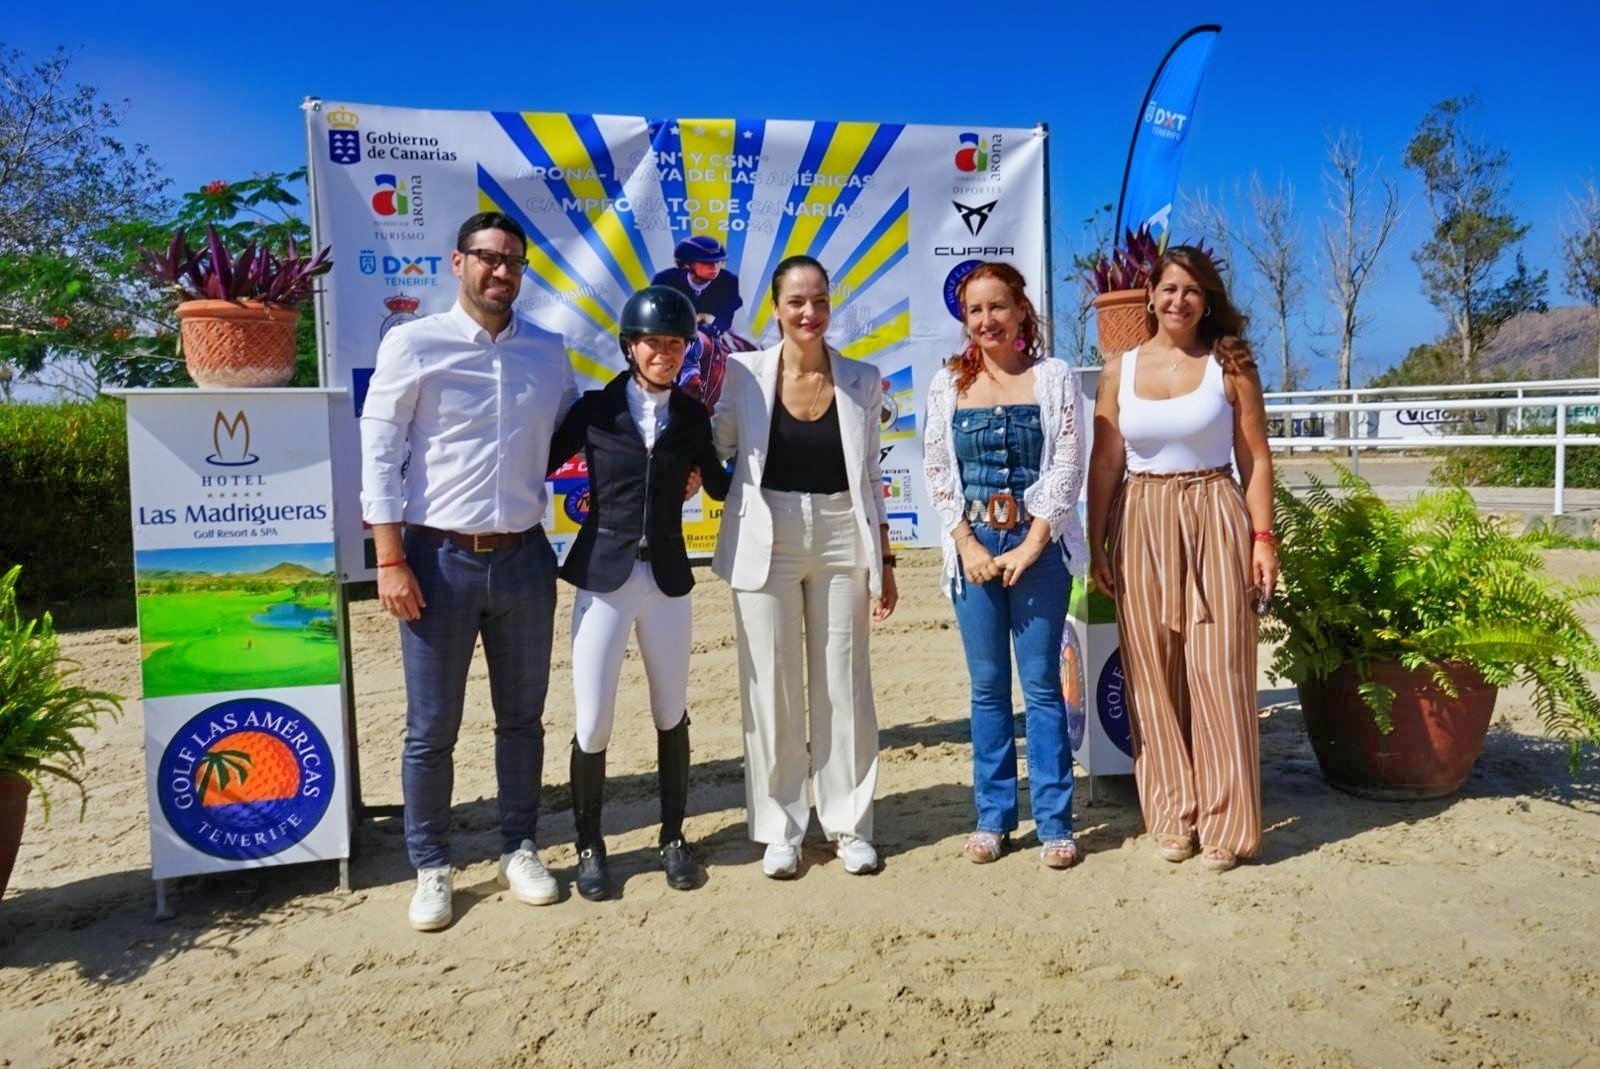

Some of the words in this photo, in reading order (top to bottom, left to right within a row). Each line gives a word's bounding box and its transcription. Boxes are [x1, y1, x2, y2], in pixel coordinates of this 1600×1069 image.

[1154, 108, 1187, 131] DXT
[366, 131, 439, 147] Gobierno
[367, 147, 385, 160] de
[389, 147, 457, 163] Canarias
[690, 152, 703, 165] Y
[614, 168, 682, 182] PLAYA
[689, 169, 716, 182] DE
[723, 170, 761, 186] LAS
[765, 170, 876, 188] AMÉRICAS
[953, 186, 1002, 194] DEPORTES
[526, 197, 701, 213] CAMPEONATO
[708, 199, 740, 213] DE
[746, 200, 864, 218] CANARIAS
[634, 215, 710, 231] SALTO
[717, 218, 774, 234] 2024
[373, 231, 425, 241] TURISMO
[935, 247, 1015, 256] CUPRA
[383, 256, 443, 275] DXT
[384, 277, 438, 287] TENERIFE
[202, 474, 266, 487] HOTEL
[139, 506, 177, 525] Las
[185, 502, 327, 525] Madrigueras
[193, 529, 215, 539] Golf
[217, 529, 248, 538] Resort
[250, 529, 258, 537] &
[260, 527, 278, 537] SPA
[1107, 666, 1125, 719] GOLF
[172, 747, 197, 810] GOLF
[191, 712, 238, 748] LAS
[244, 710, 322, 798] AMÉRICAS
[197, 813, 302, 847] TENERIFE
